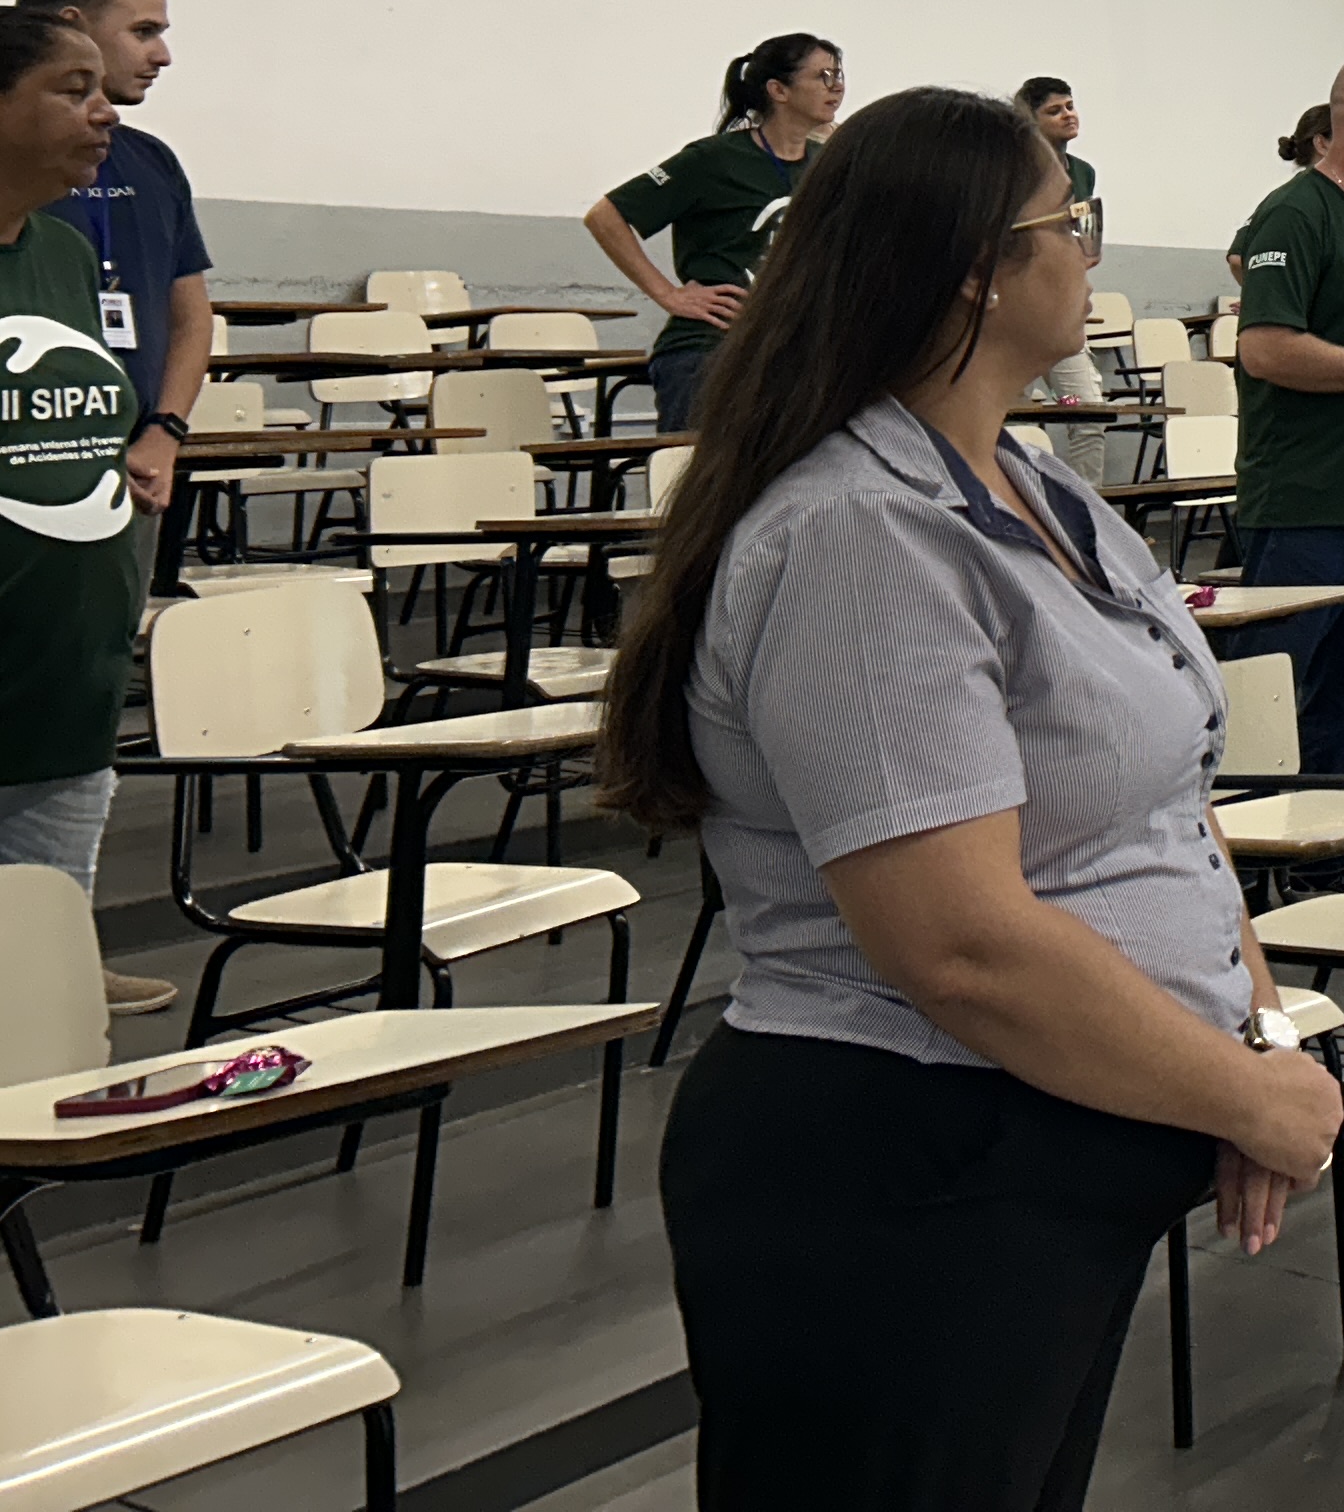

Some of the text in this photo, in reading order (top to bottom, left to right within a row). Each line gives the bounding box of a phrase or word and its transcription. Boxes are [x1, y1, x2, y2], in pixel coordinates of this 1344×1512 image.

[2, 385, 120, 420] II SIPAT
[0, 442, 40, 454] emana
[9, 456, 26, 465] de
[28, 452, 79, 463] Acidentes
[81, 450, 93, 459] de
